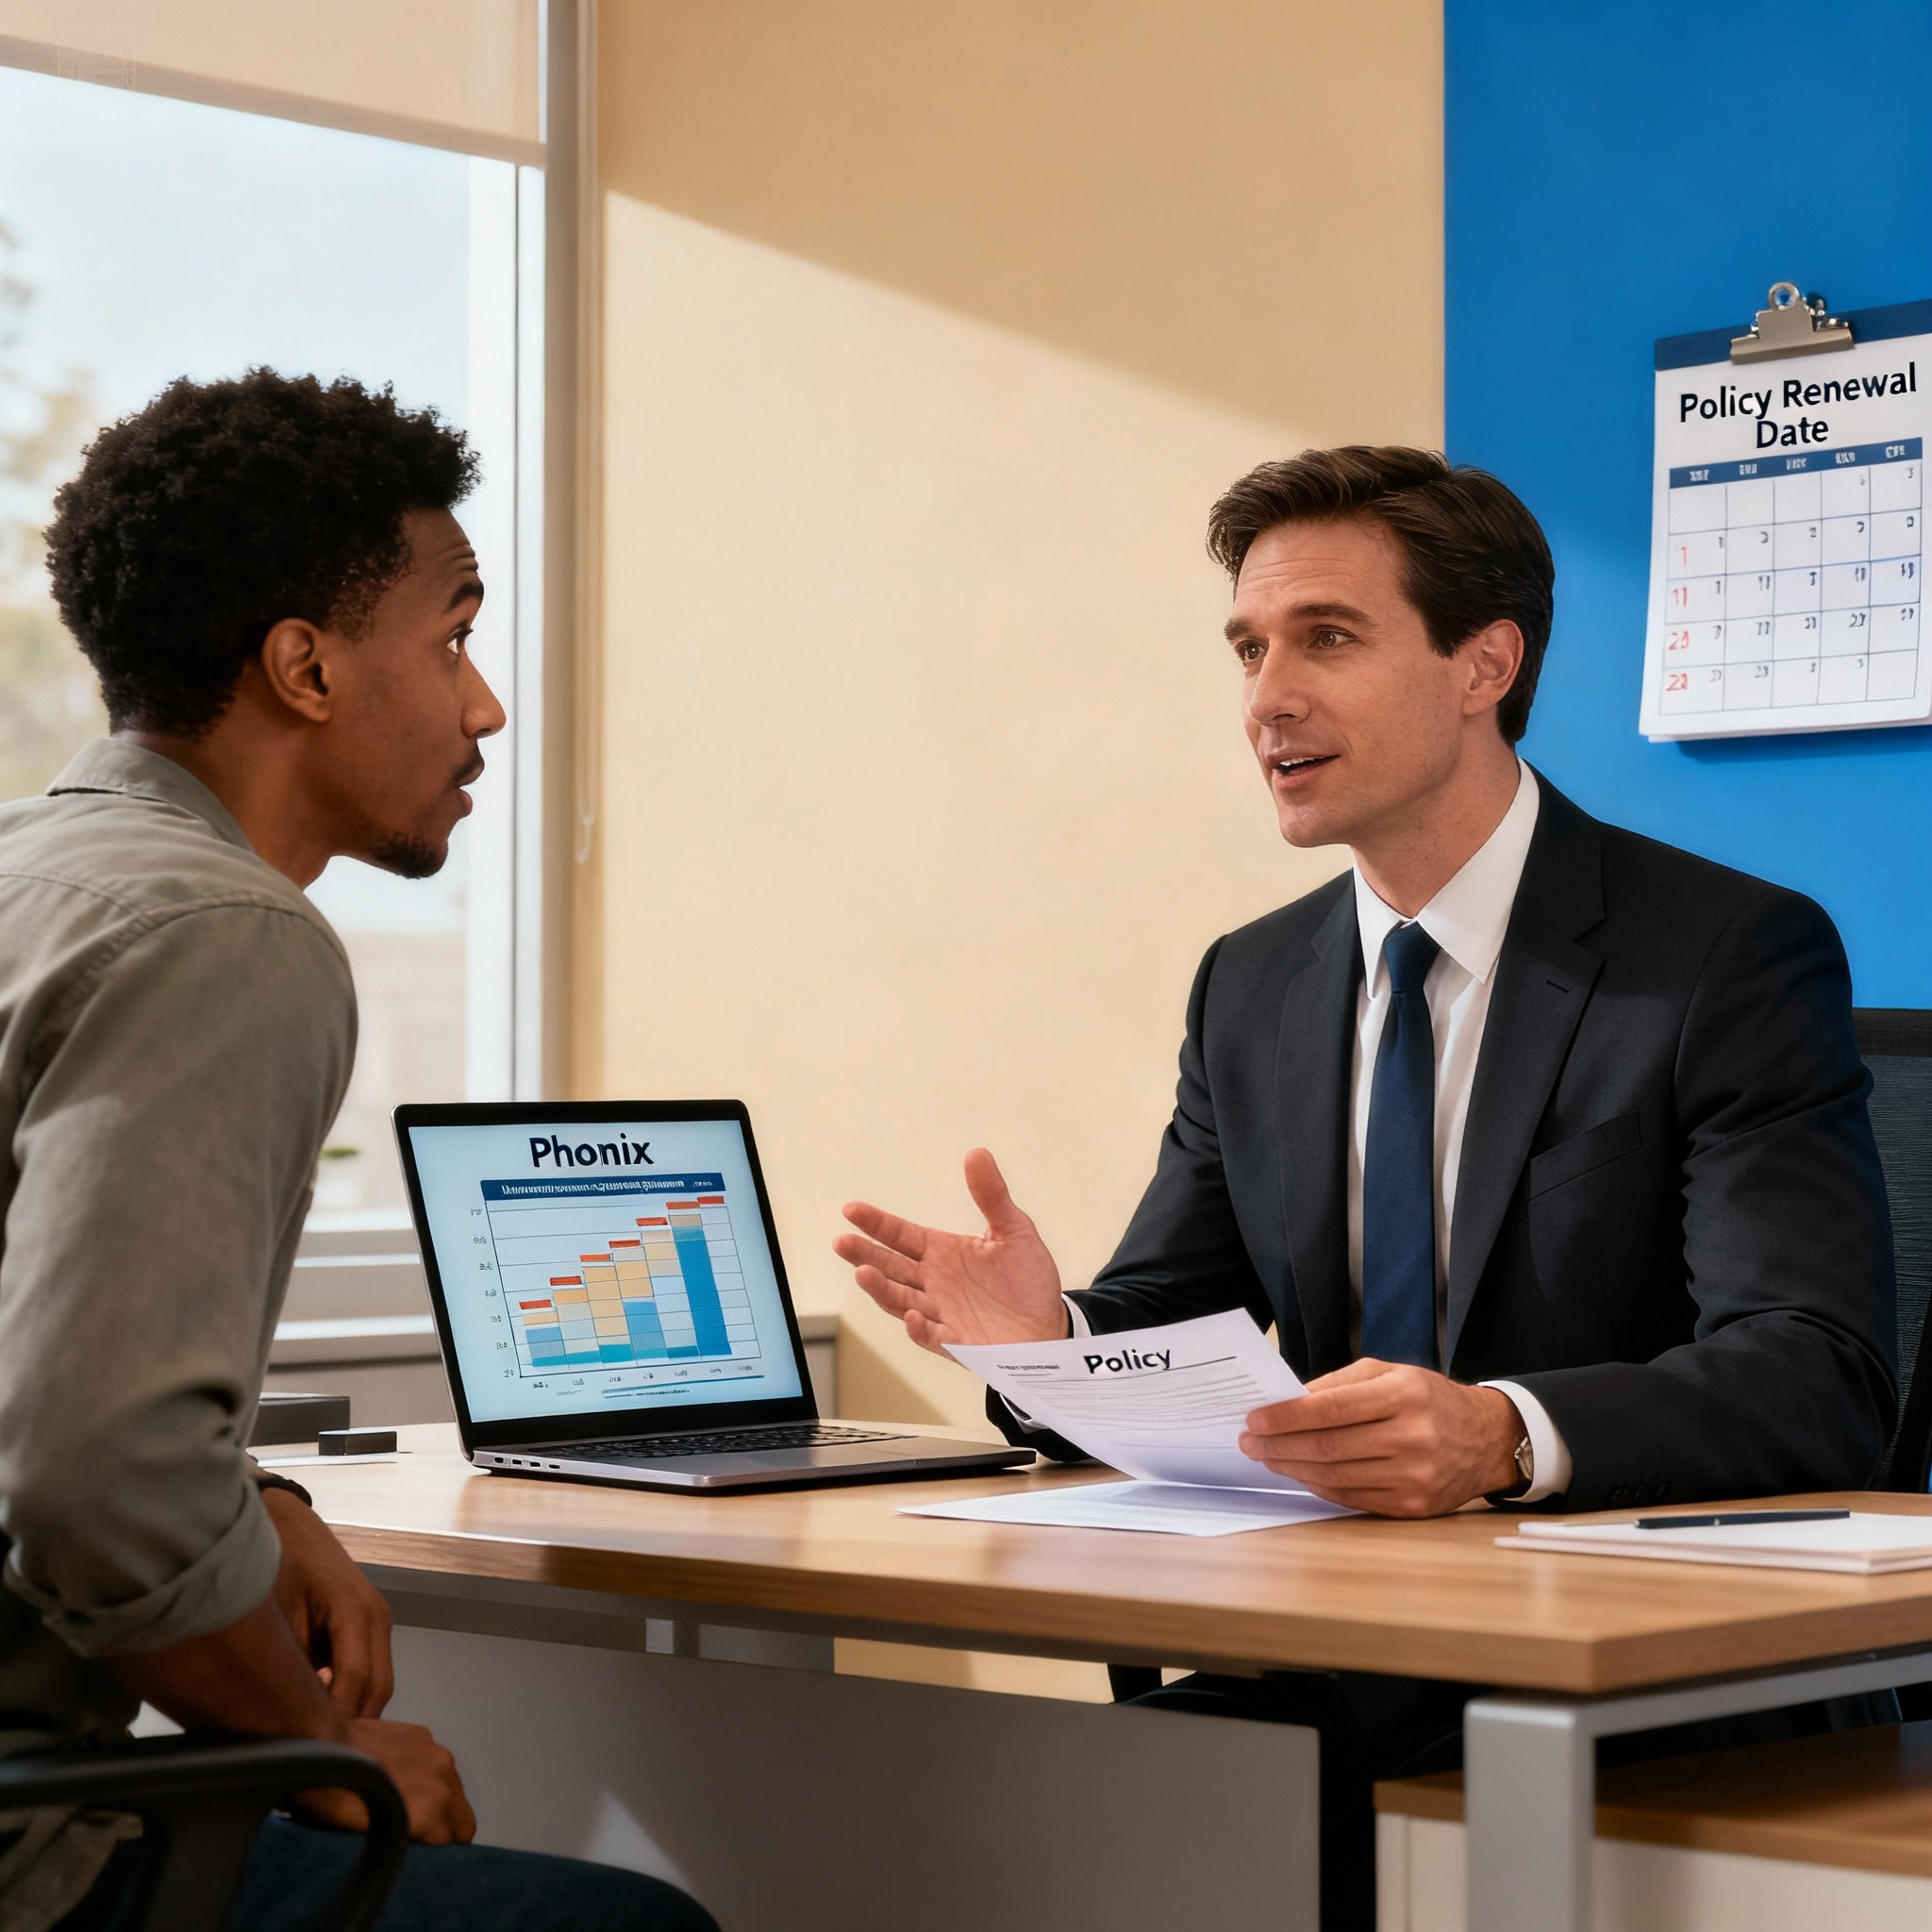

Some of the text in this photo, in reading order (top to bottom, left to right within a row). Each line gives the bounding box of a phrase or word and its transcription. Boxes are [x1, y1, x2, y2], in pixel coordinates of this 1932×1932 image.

[1680, 360, 1917, 423] Policy Renewal
[1756, 416, 1829, 449] Date
[528, 1132, 655, 1168] Phonix
[1083, 1348, 1171, 1374] Policy
